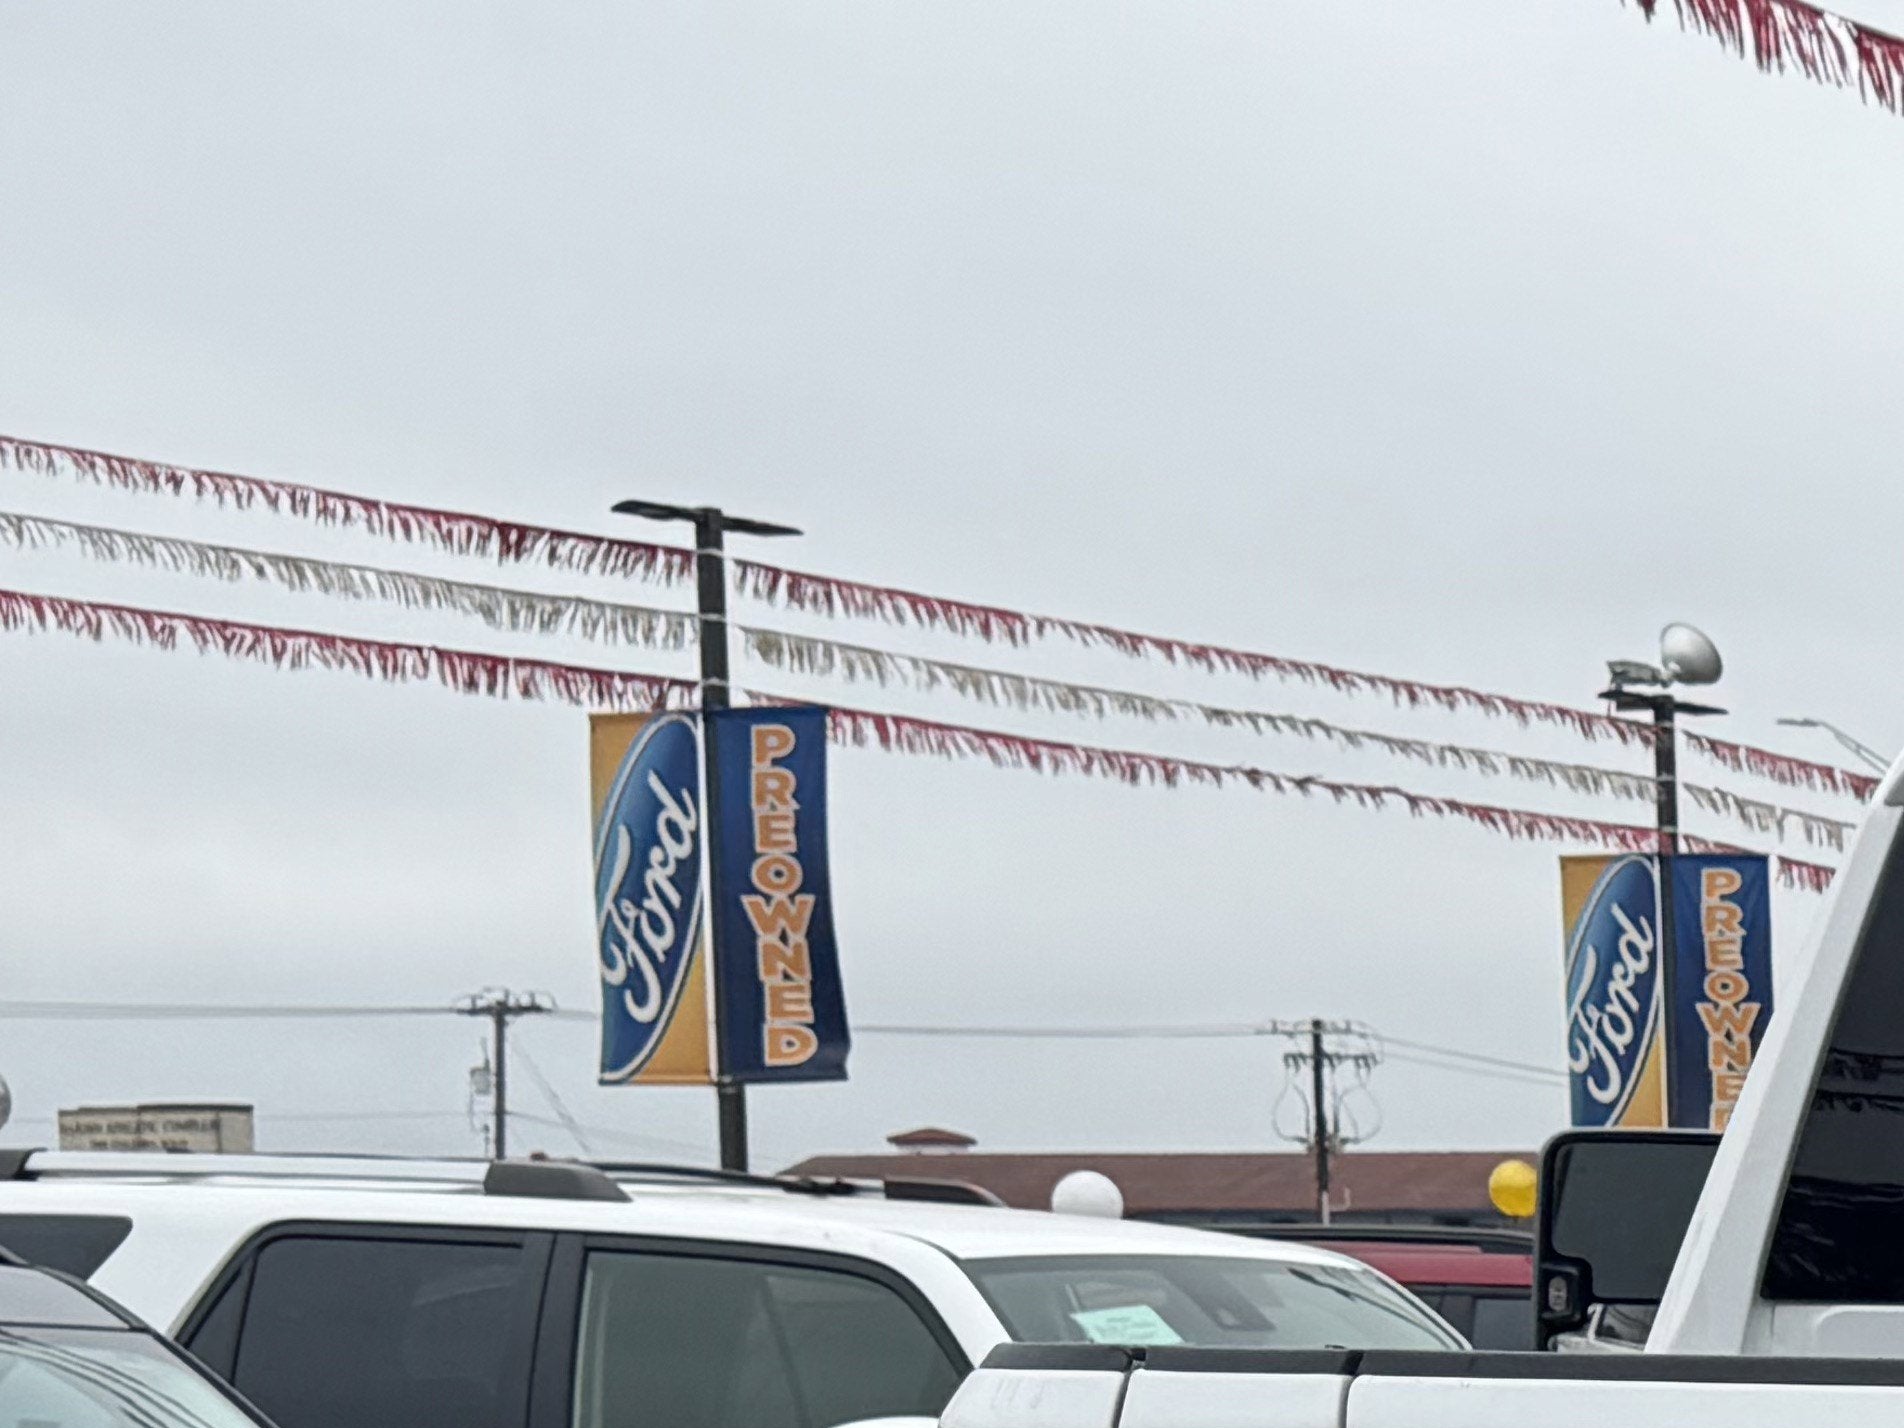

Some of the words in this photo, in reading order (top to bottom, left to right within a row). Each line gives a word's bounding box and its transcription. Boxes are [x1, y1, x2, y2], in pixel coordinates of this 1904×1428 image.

[599, 769, 698, 1024] Ford
[741, 724, 818, 1067] PREOWNED
[1569, 903, 1654, 1104] Ford
